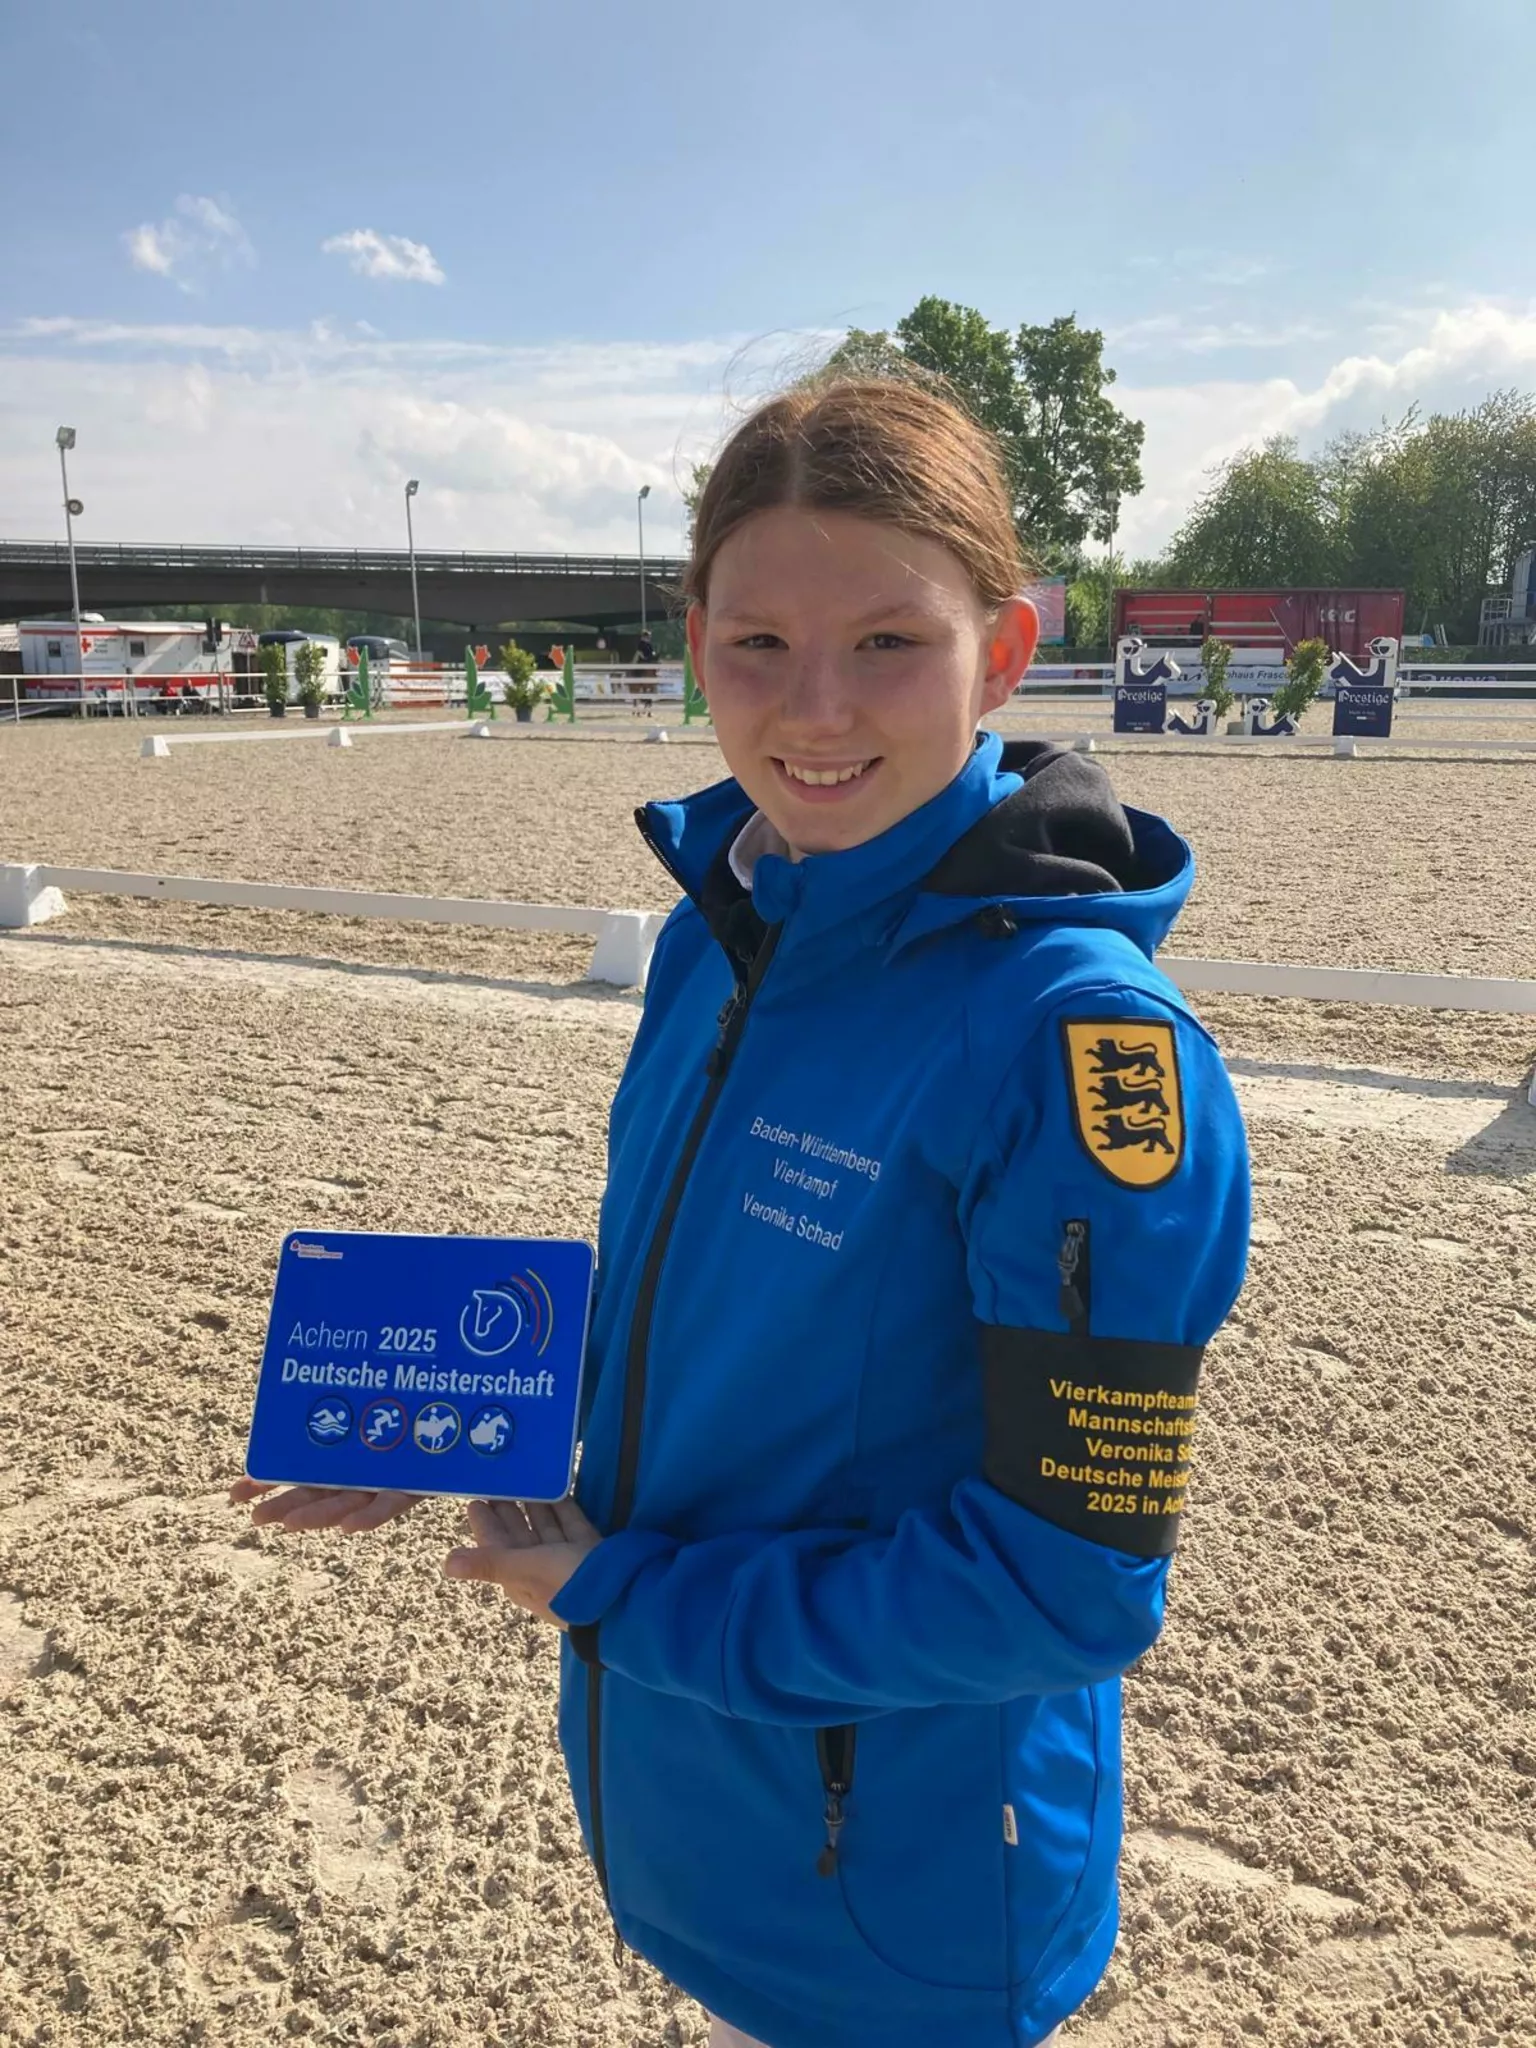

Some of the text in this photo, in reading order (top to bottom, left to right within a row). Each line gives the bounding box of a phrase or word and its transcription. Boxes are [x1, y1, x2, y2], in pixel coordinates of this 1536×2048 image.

[1338, 689, 1390, 706] Prestige
[750, 1116, 881, 1181] Baden-Württemberg
[773, 1158, 839, 1200] Vierkampf
[742, 1192, 844, 1251] Veronika Schad
[288, 1321, 437, 1352] Achern 2025
[281, 1359, 555, 1397] Deutsche Meisterschaft
[1086, 1437, 1173, 1462] Veronika
[1041, 1457, 1143, 1487] Deutsche
[1087, 1492, 1137, 1513] 2025
[1143, 1496, 1159, 1515] in
